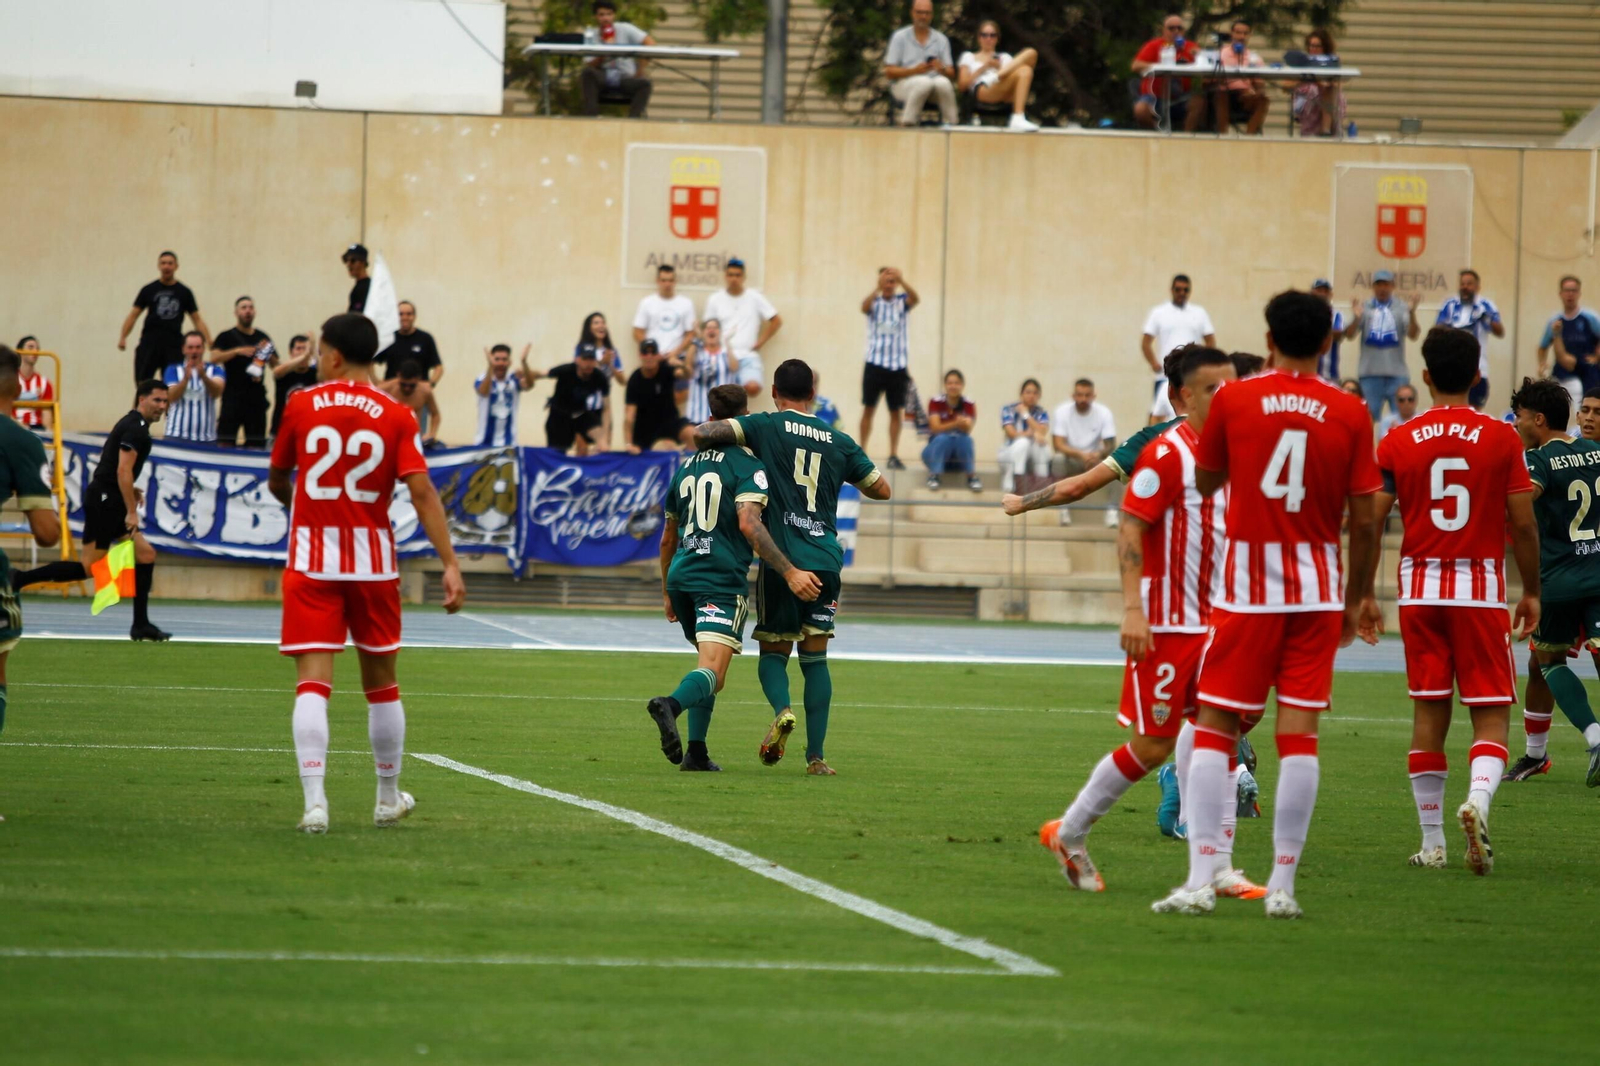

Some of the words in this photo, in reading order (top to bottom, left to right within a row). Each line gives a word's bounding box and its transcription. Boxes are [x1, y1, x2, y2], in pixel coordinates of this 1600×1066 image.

[644, 250, 728, 272] ALMERÍ
[1352, 269, 1448, 291] ALERÍA
[312, 390, 384, 419] ALBERTO
[1261, 393, 1328, 423] MIGUEL
[784, 420, 833, 444] BONAQUE
[1411, 423, 1444, 444] EDU
[1448, 423, 1484, 444] PLÁ
[305, 425, 385, 504] 22
[1260, 428, 1308, 512] 4
[1549, 454, 1586, 471] NESTOR
[793, 448, 822, 512] 4
[1430, 457, 1470, 531] 5
[680, 472, 723, 537] 20
[1154, 662, 1176, 700] 2
[1420, 803, 1440, 811] UDA
